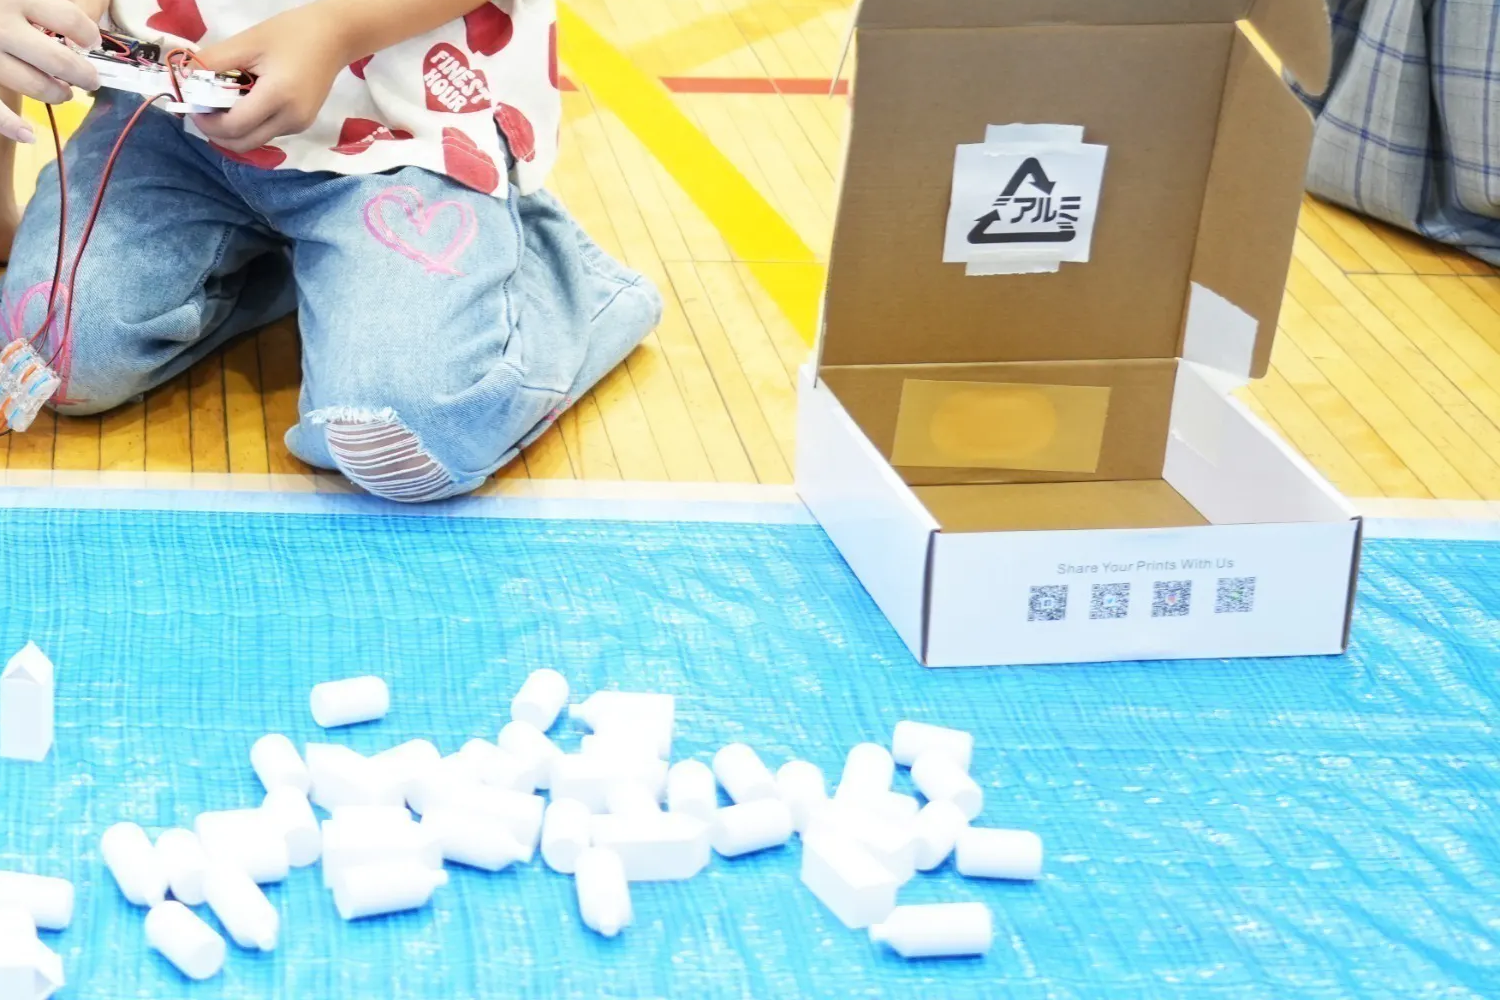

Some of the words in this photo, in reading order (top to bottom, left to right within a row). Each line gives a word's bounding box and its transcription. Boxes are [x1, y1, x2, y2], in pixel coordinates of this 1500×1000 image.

[423, 68, 468, 113] HOUR
[430, 50, 491, 104] FINEST
[1010, 196, 1082, 224] アルミ
[1056, 563, 1098, 575] Share
[1102, 561, 1134, 573] Your
[1137, 560, 1177, 571] Prints
[1180, 558, 1212, 570] With
[1216, 557, 1235, 569] Us
